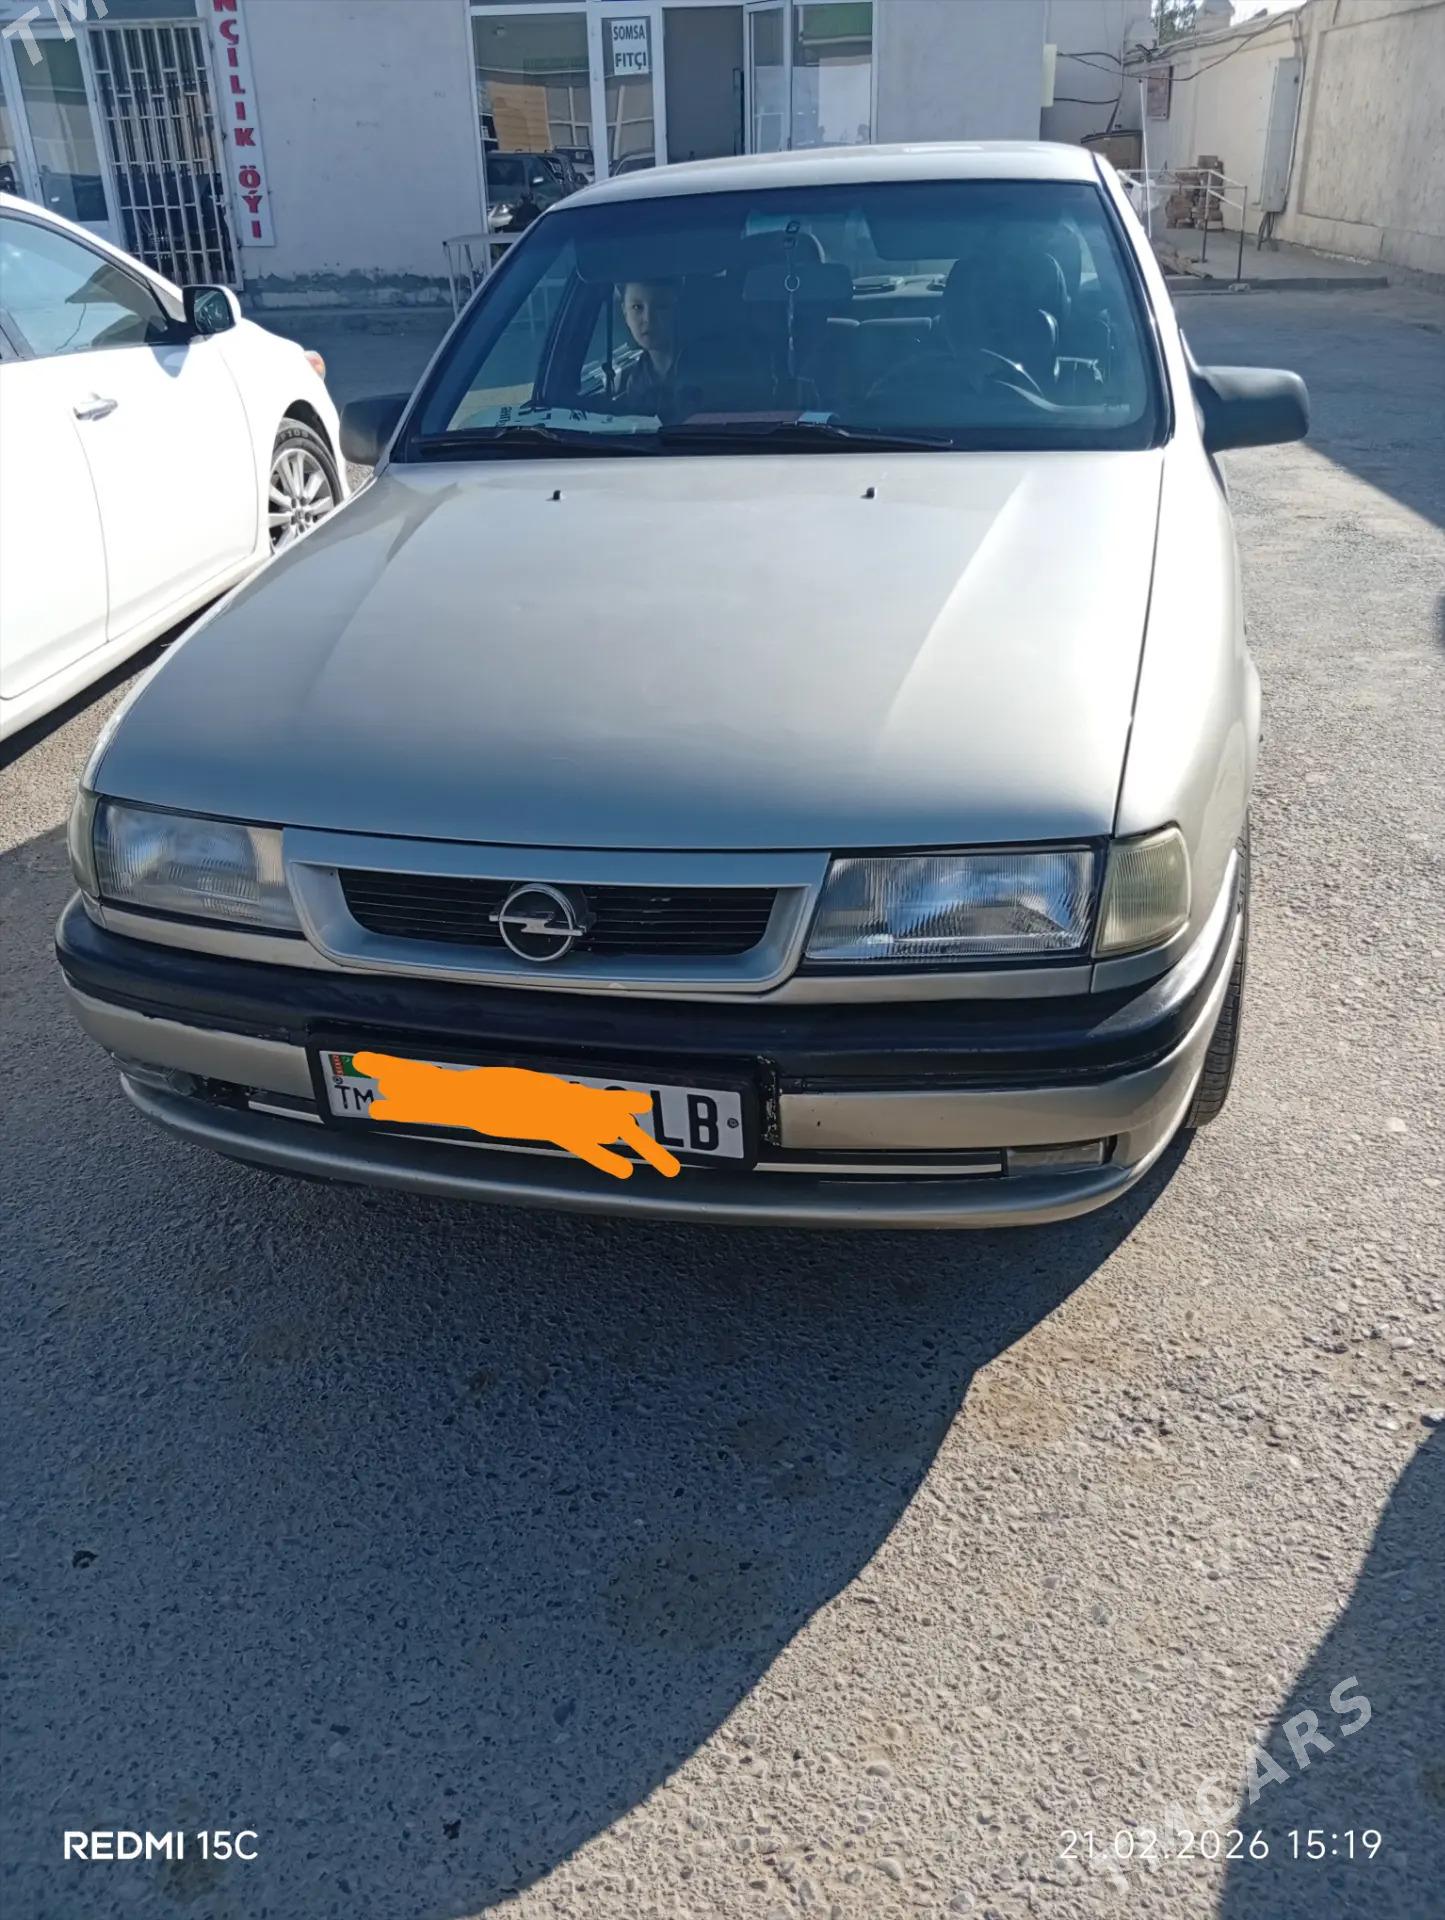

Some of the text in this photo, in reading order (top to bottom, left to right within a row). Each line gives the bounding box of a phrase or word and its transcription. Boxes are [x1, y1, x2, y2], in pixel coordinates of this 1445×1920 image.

[613, 25, 646, 40] SOMSA
[615, 52, 647, 70] FITÇI
[239, 164, 263, 239] ÖÝI
[334, 1085, 375, 1111] TM
[650, 1089, 720, 1151] LB
